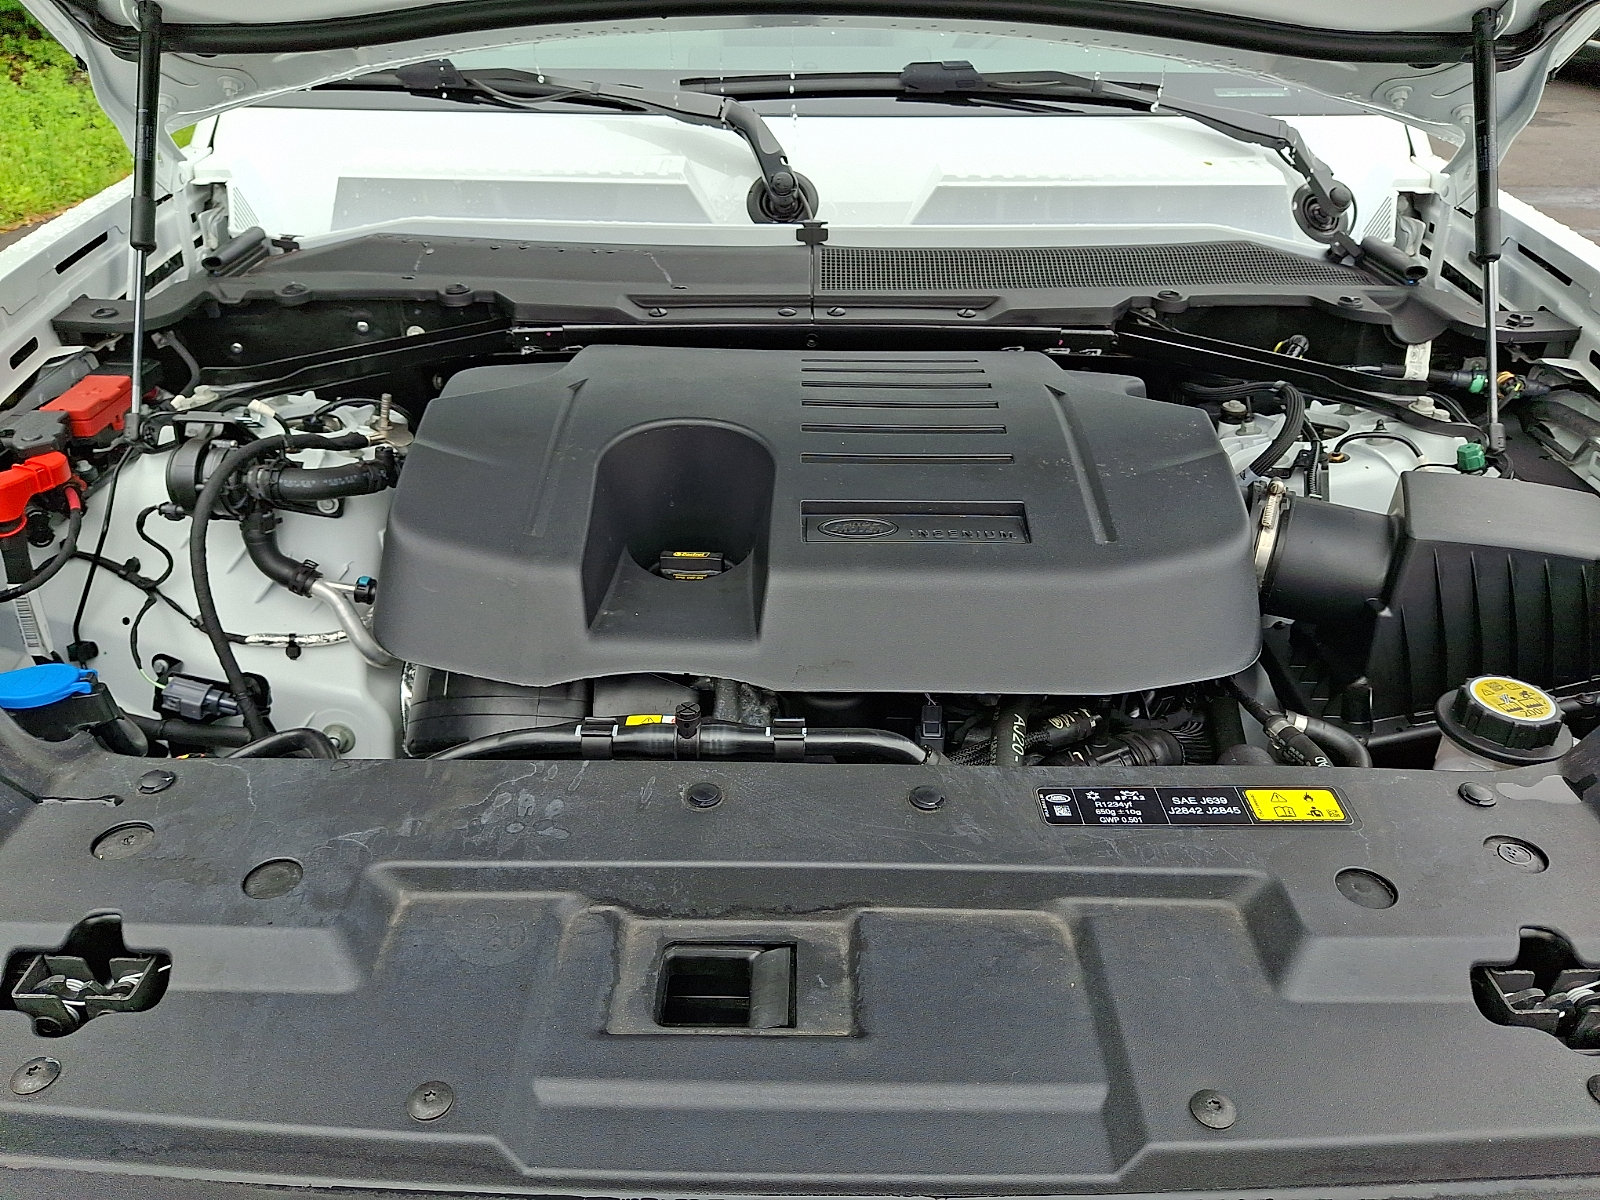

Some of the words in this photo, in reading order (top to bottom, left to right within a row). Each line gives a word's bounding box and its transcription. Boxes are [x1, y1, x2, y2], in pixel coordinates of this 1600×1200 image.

[1171, 796, 1199, 805] SAE
[1200, 796, 1228, 805] J639
[1095, 808, 1117, 816] 650g
[1168, 806, 1203, 815] J2842
[1205, 806, 1242, 815] J2845
[1099, 816, 1120, 824] GWP
[1121, 816, 1144, 824] 0.501
